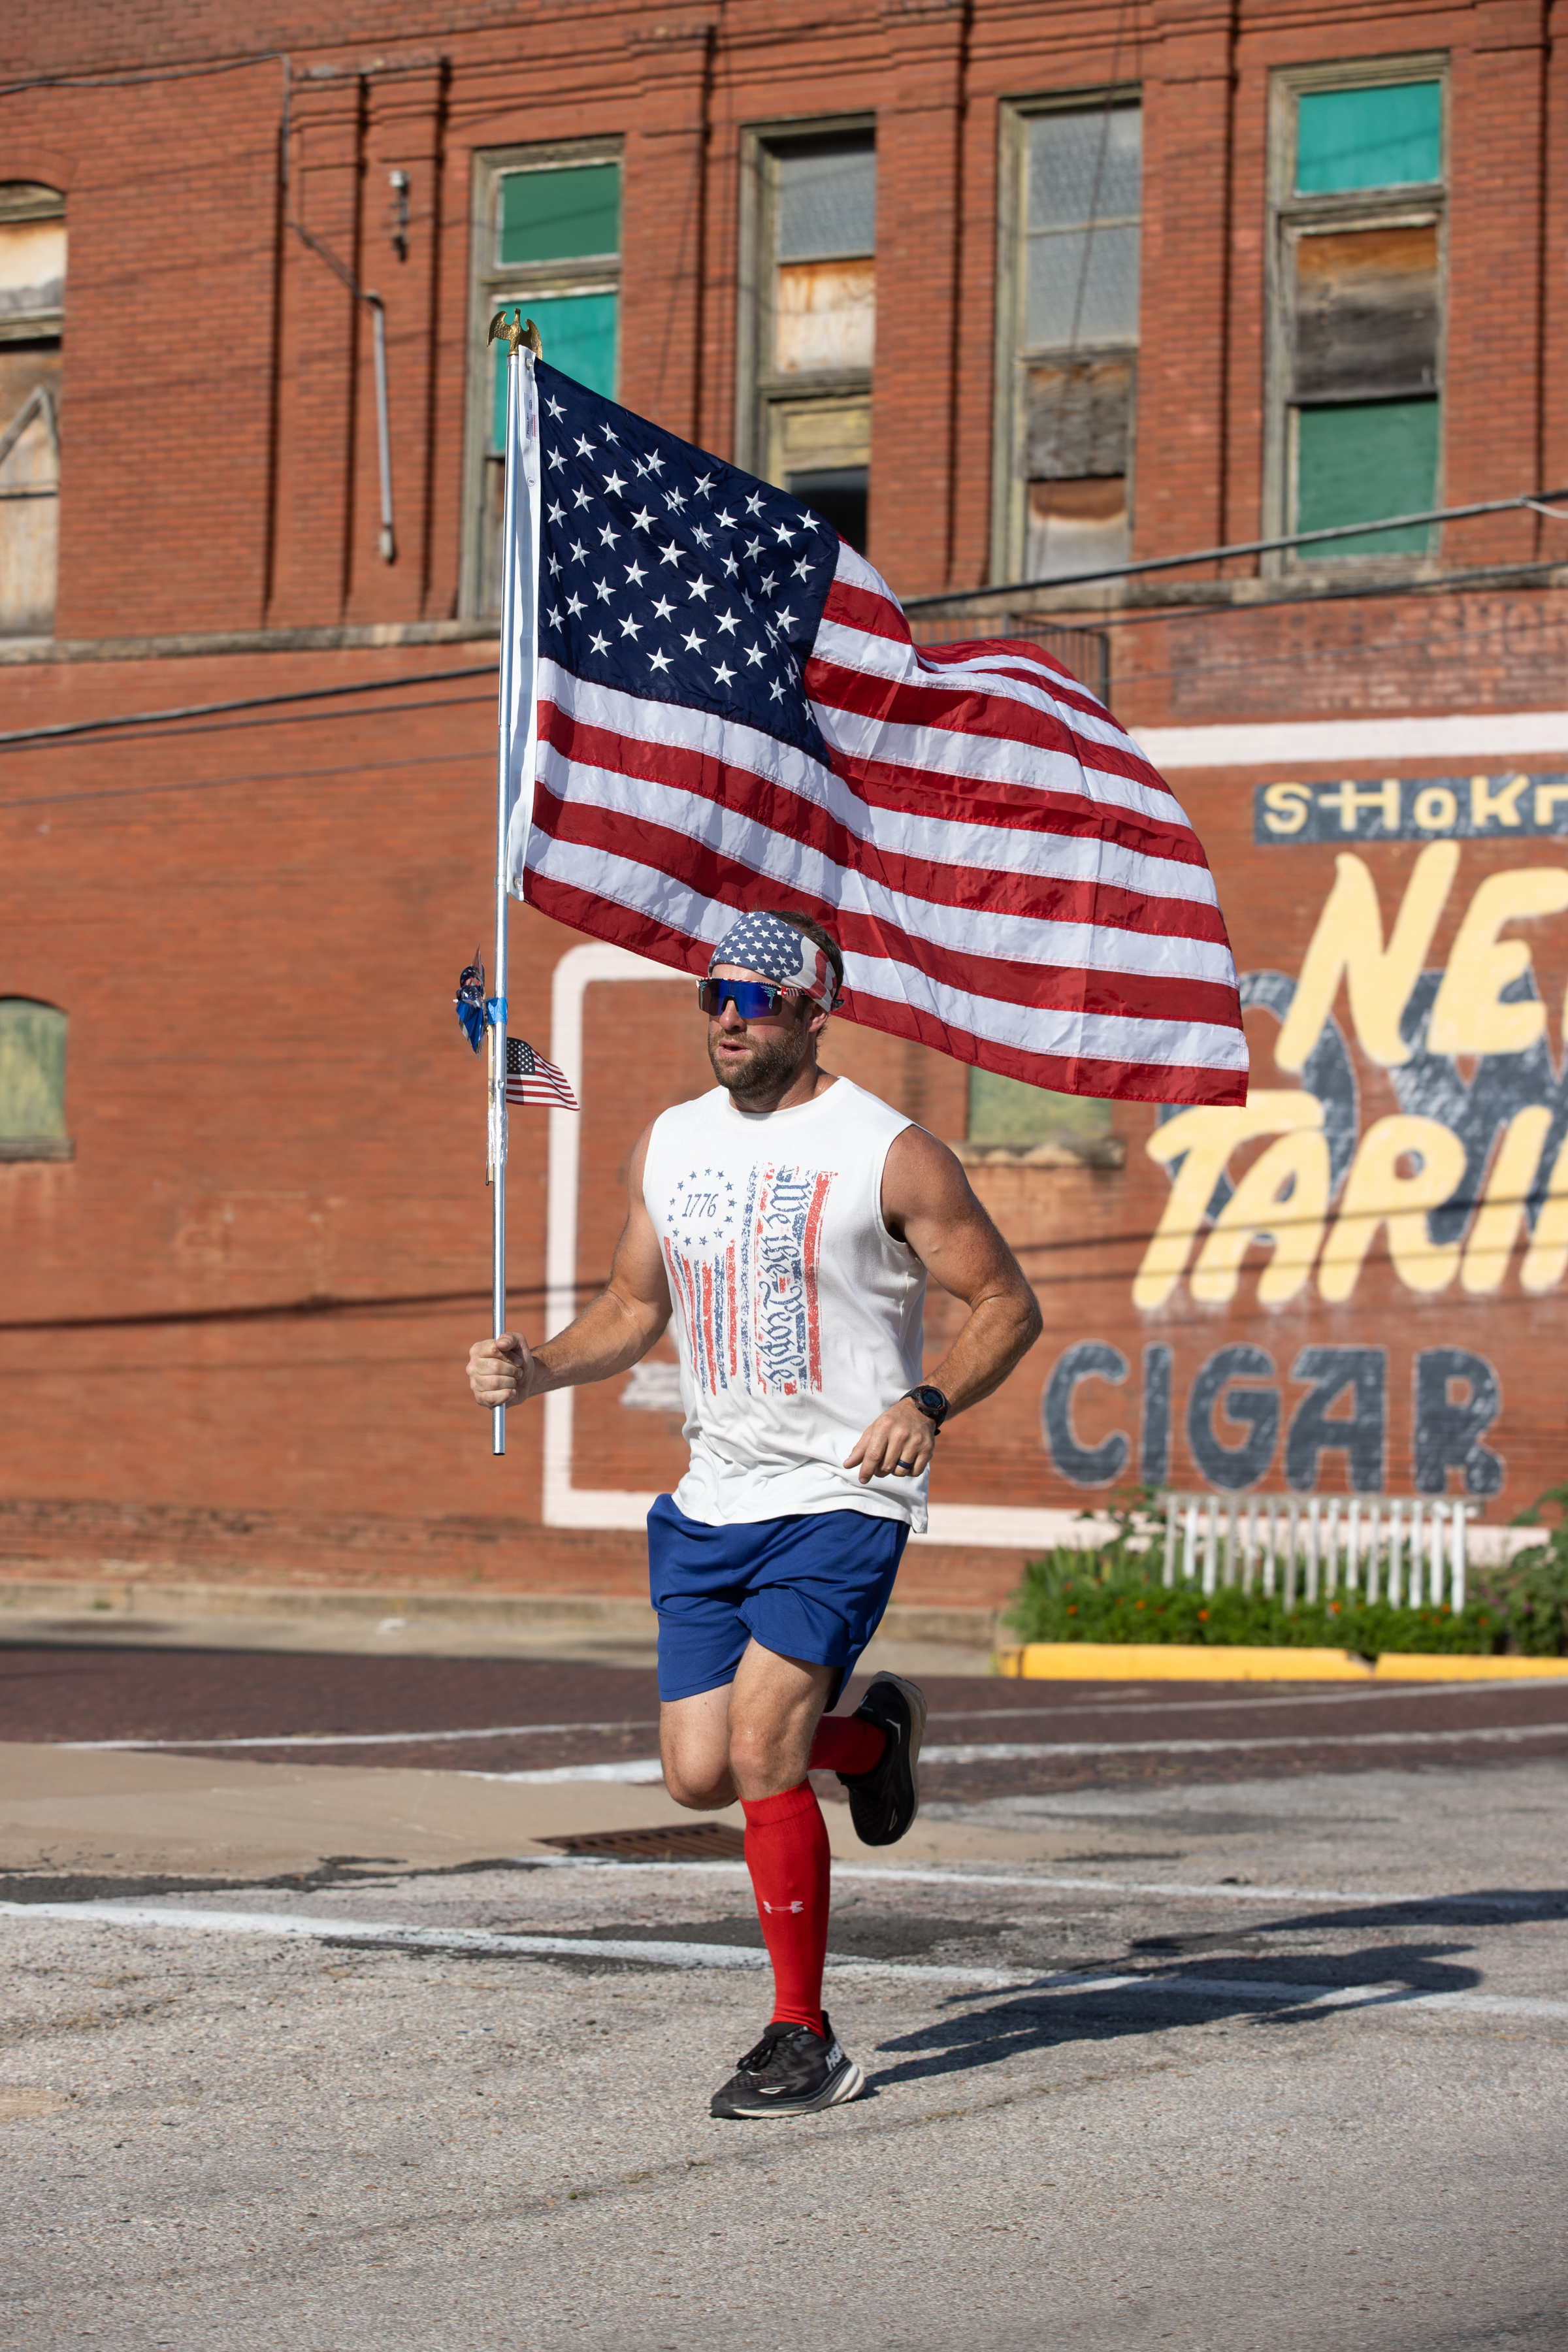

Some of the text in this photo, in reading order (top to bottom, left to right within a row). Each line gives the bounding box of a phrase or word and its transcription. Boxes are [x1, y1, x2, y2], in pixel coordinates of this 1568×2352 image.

[1273, 839, 1568, 1073] NE
[681, 1193, 719, 1218] 1776
[755, 1180, 811, 1386] We the People
[1042, 1339, 1507, 1497] CIGAR
